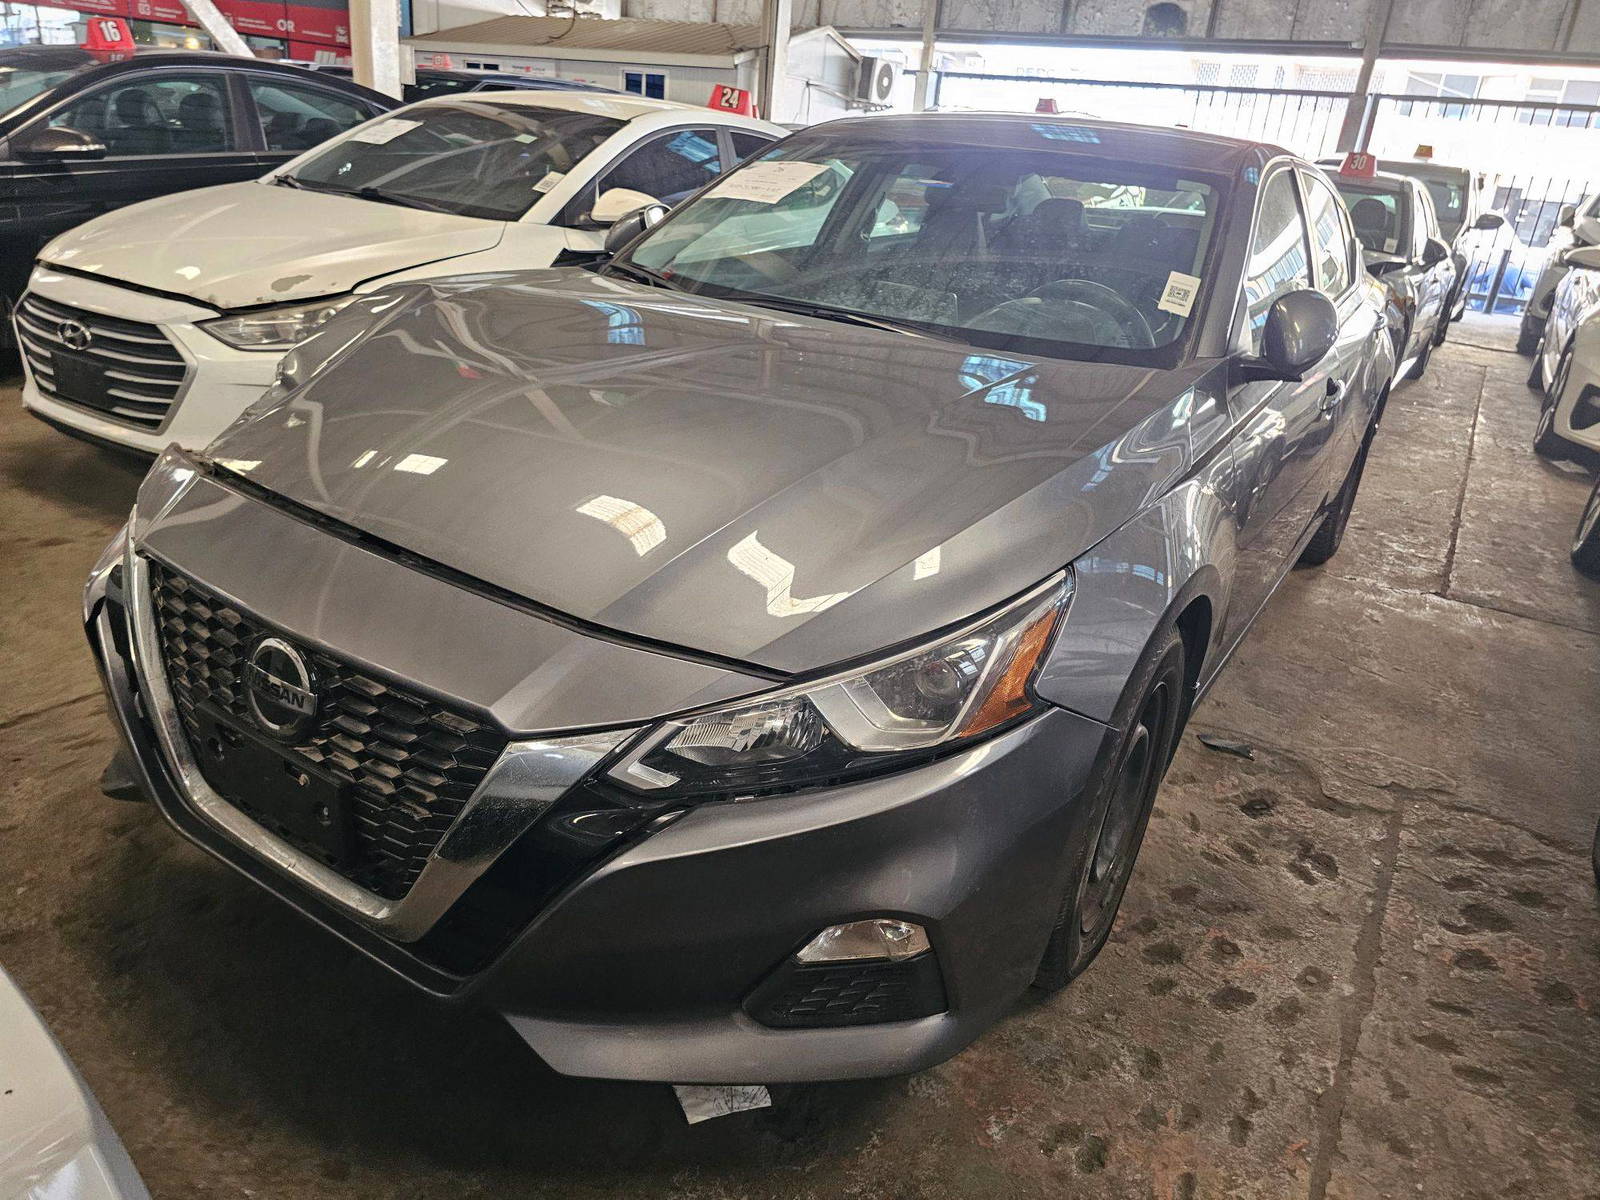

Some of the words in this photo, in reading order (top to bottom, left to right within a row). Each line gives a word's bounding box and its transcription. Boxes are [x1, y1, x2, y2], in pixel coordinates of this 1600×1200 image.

[99, 20, 122, 42] 16
[276, 19, 296, 33] OR
[720, 87, 740, 109] 24
[1351, 155, 1367, 169] 30
